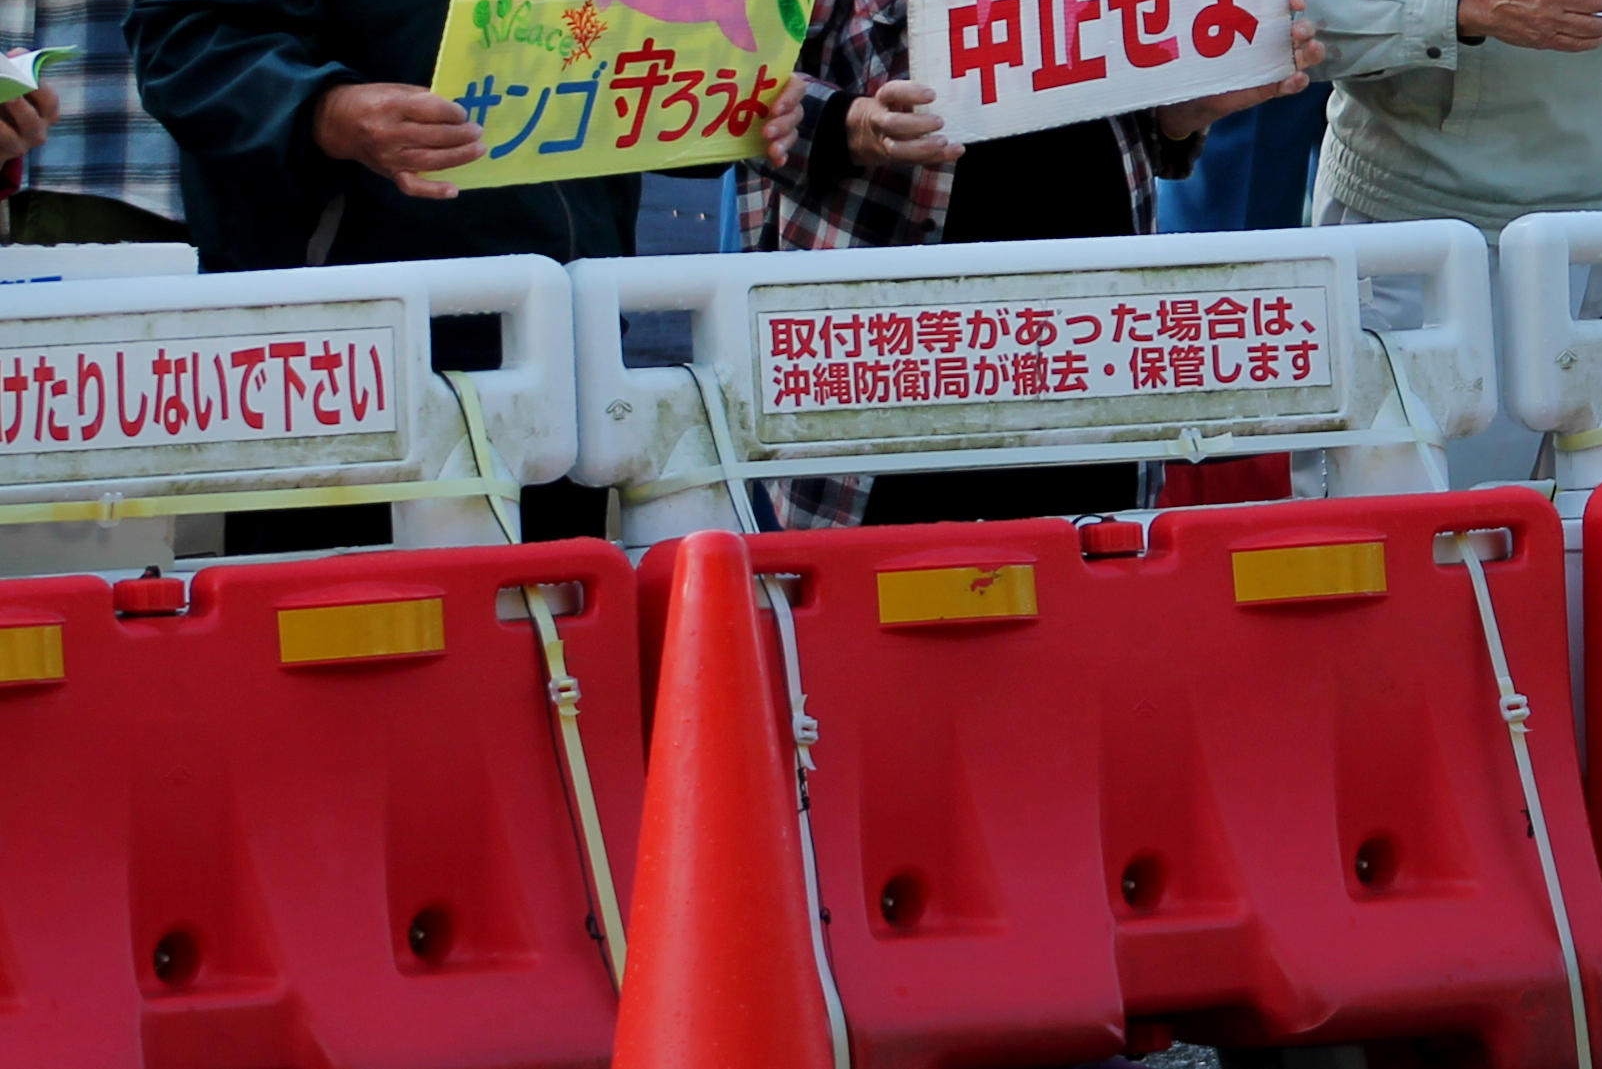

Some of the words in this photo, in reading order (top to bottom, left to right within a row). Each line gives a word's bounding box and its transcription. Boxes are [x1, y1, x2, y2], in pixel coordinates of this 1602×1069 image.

[769, 296, 1317, 361] 取付物等があった場合は、
[773, 340, 1320, 408] 沖縄防衛局が撤去・保管します
